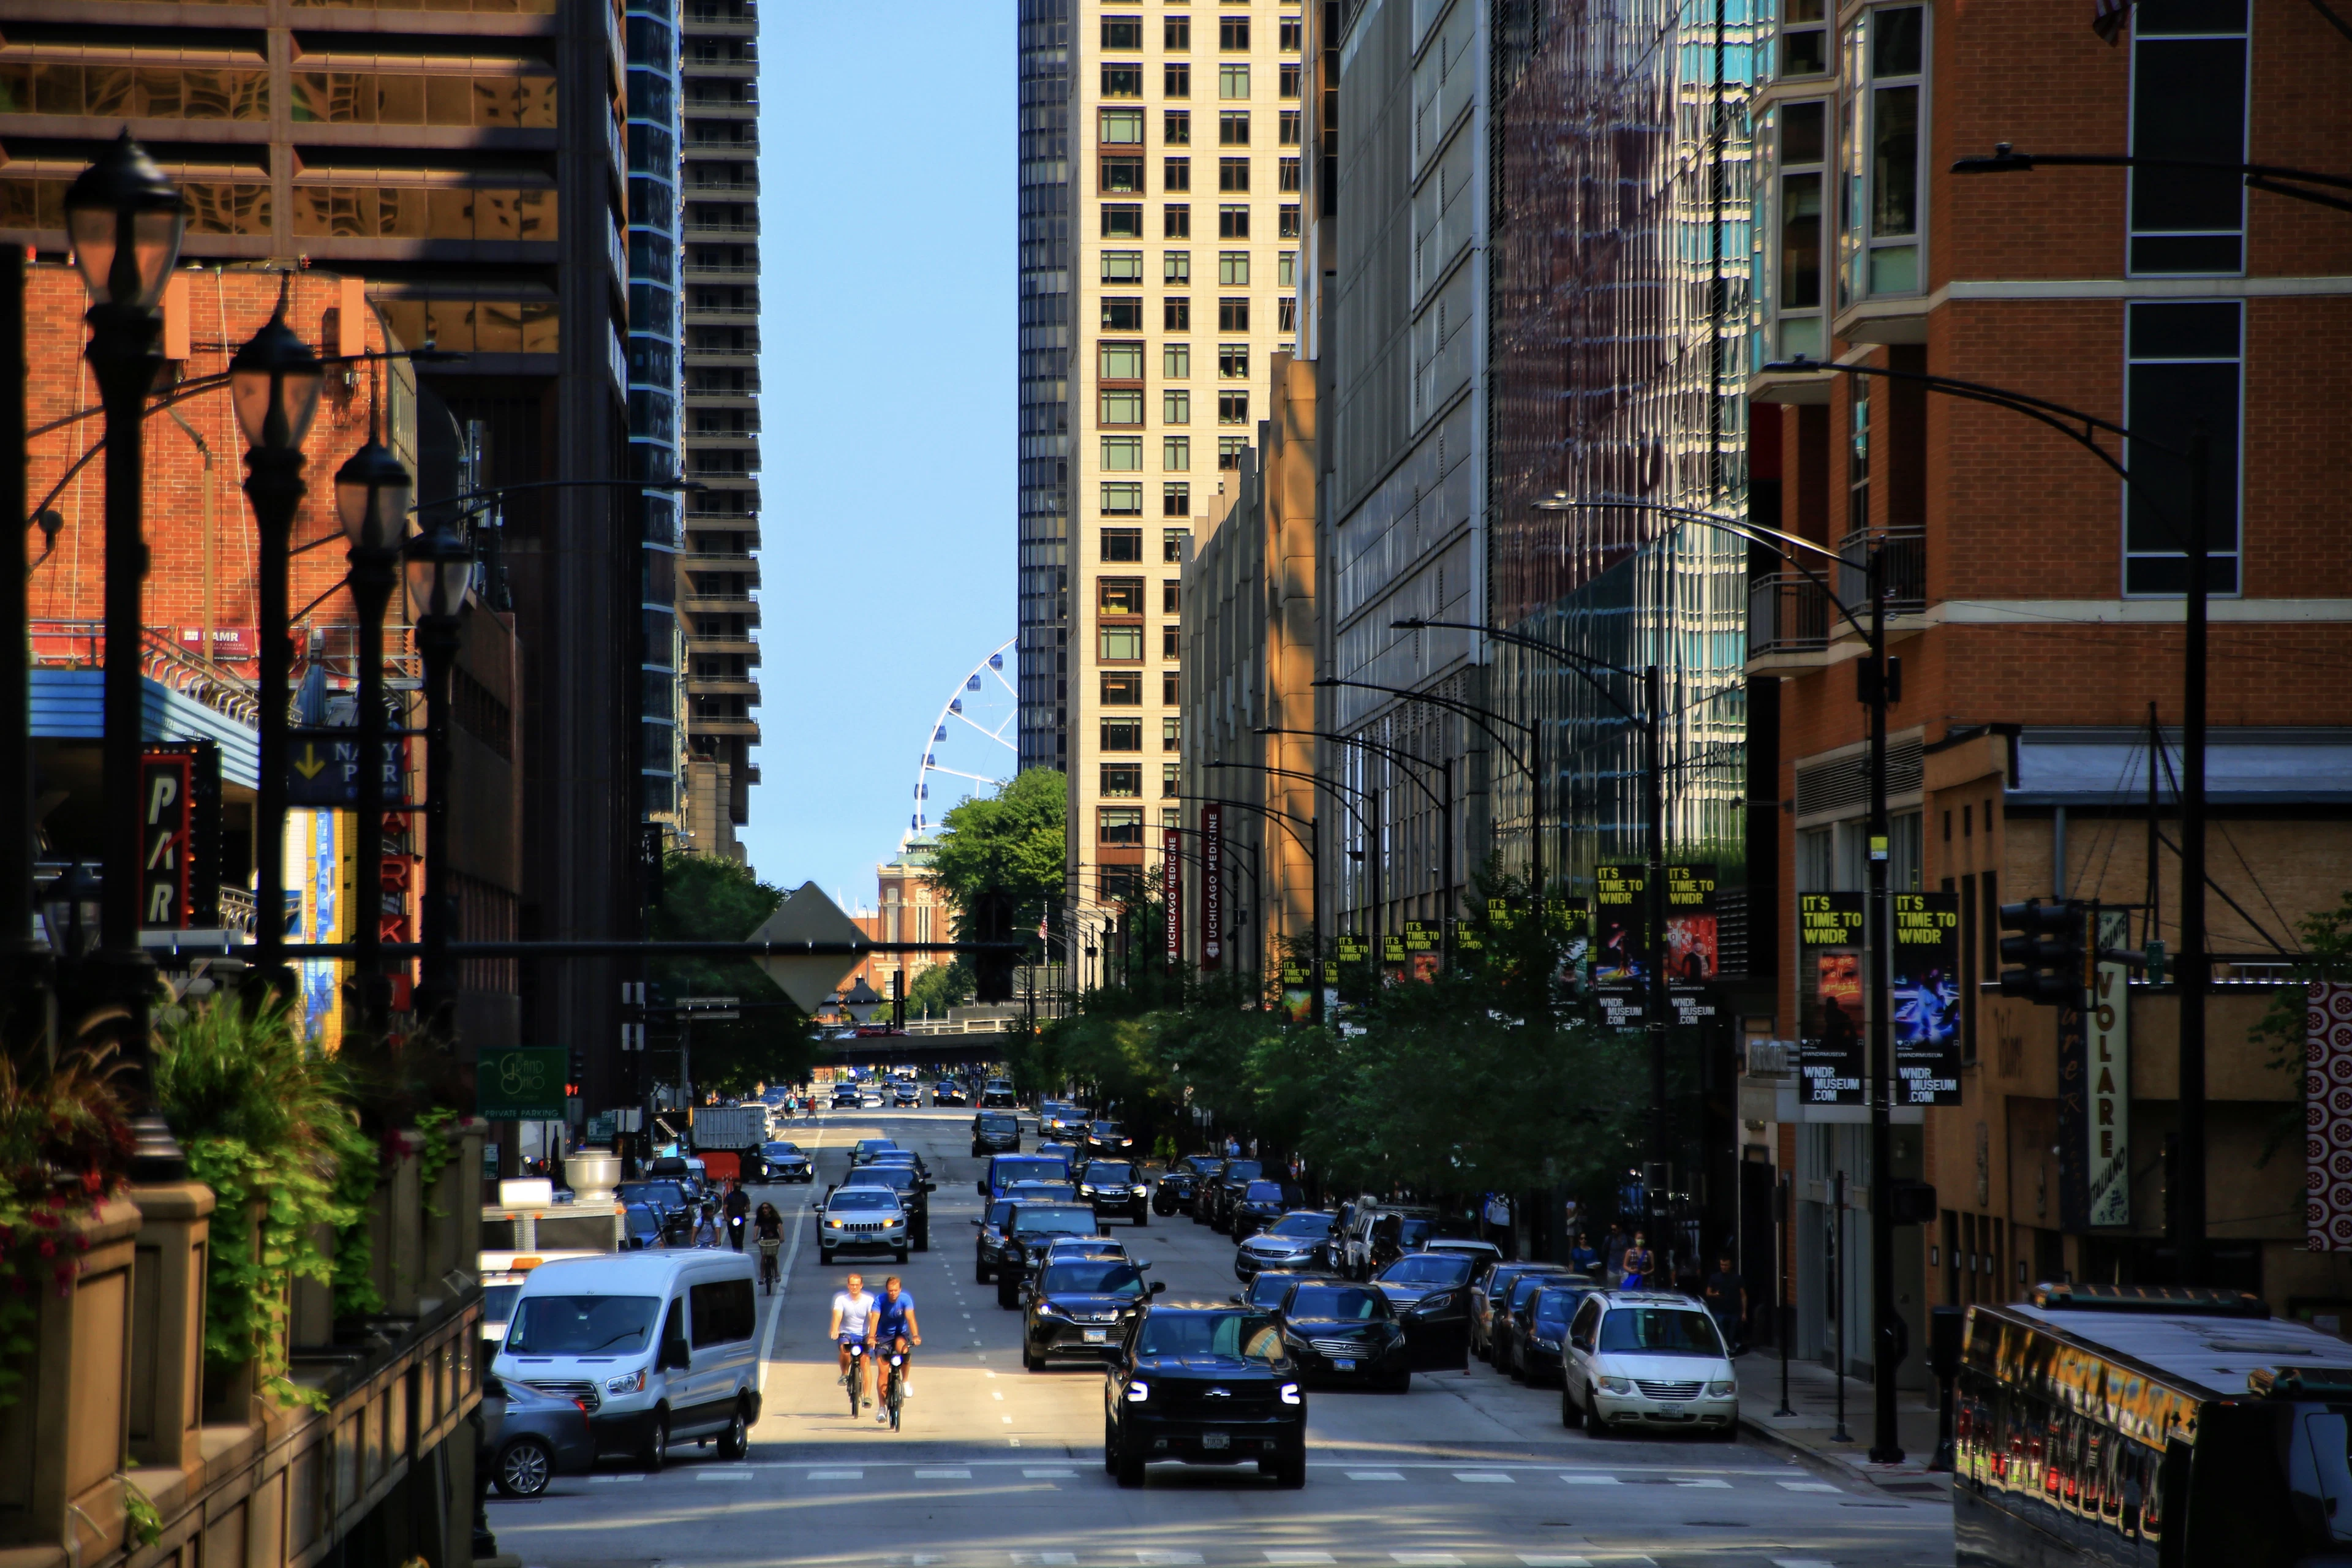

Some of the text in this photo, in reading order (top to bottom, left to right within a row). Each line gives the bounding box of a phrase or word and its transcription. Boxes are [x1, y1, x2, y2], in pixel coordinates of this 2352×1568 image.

[343, 764, 398, 782] PR
[1598, 867, 1619, 879] IT'S
[1668, 867, 1690, 880] IT'S
[1598, 880, 1643, 892] TIME TO
[1669, 880, 1714, 892] TIME TO
[1488, 899, 1507, 909] IT'S
[1599, 892, 1632, 905] WNDR
[1670, 893, 1703, 905] WNDR
[1803, 895, 1830, 911] IT'S
[1897, 895, 1924, 911] IT'S
[1209, 875, 1218, 938] UCHICAGO
[1406, 922, 1422, 931] IT'S
[1803, 913, 1863, 928] TIME TO
[1897, 913, 1957, 928] TIME TO
[1406, 932, 1439, 940] TIME TO
[1803, 929, 1848, 944] WNDR
[1898, 929, 1942, 944] WNDR
[1385, 944, 1404, 953] TIME
[1406, 941, 1431, 949] WNDR
[1822, 957, 1853, 968] We are
[1830, 968, 1844, 979] all
[1824, 980, 1857, 993] artists
[1599, 998, 1624, 1008] WNDR
[1671, 998, 1696, 1008] WNDR
[1607, 1007, 1642, 1016] MUSEUM
[1679, 1006, 1715, 1016] MUSEUM
[1606, 1016, 1626, 1025] .COM
[1678, 1015, 1698, 1025] .COM
[2095, 972, 2116, 1158] VOLARE
[1804, 1066, 1836, 1078] WNDR
[1899, 1068, 1932, 1079] WNDR
[1814, 1078, 1860, 1090] MUSEUM
[1910, 1080, 1957, 1091] MUSEUM
[1811, 1090, 1837, 1101] .COM
[1909, 1091, 1934, 1102] .COM
[2089, 1146, 2125, 1212] ITALIANO
